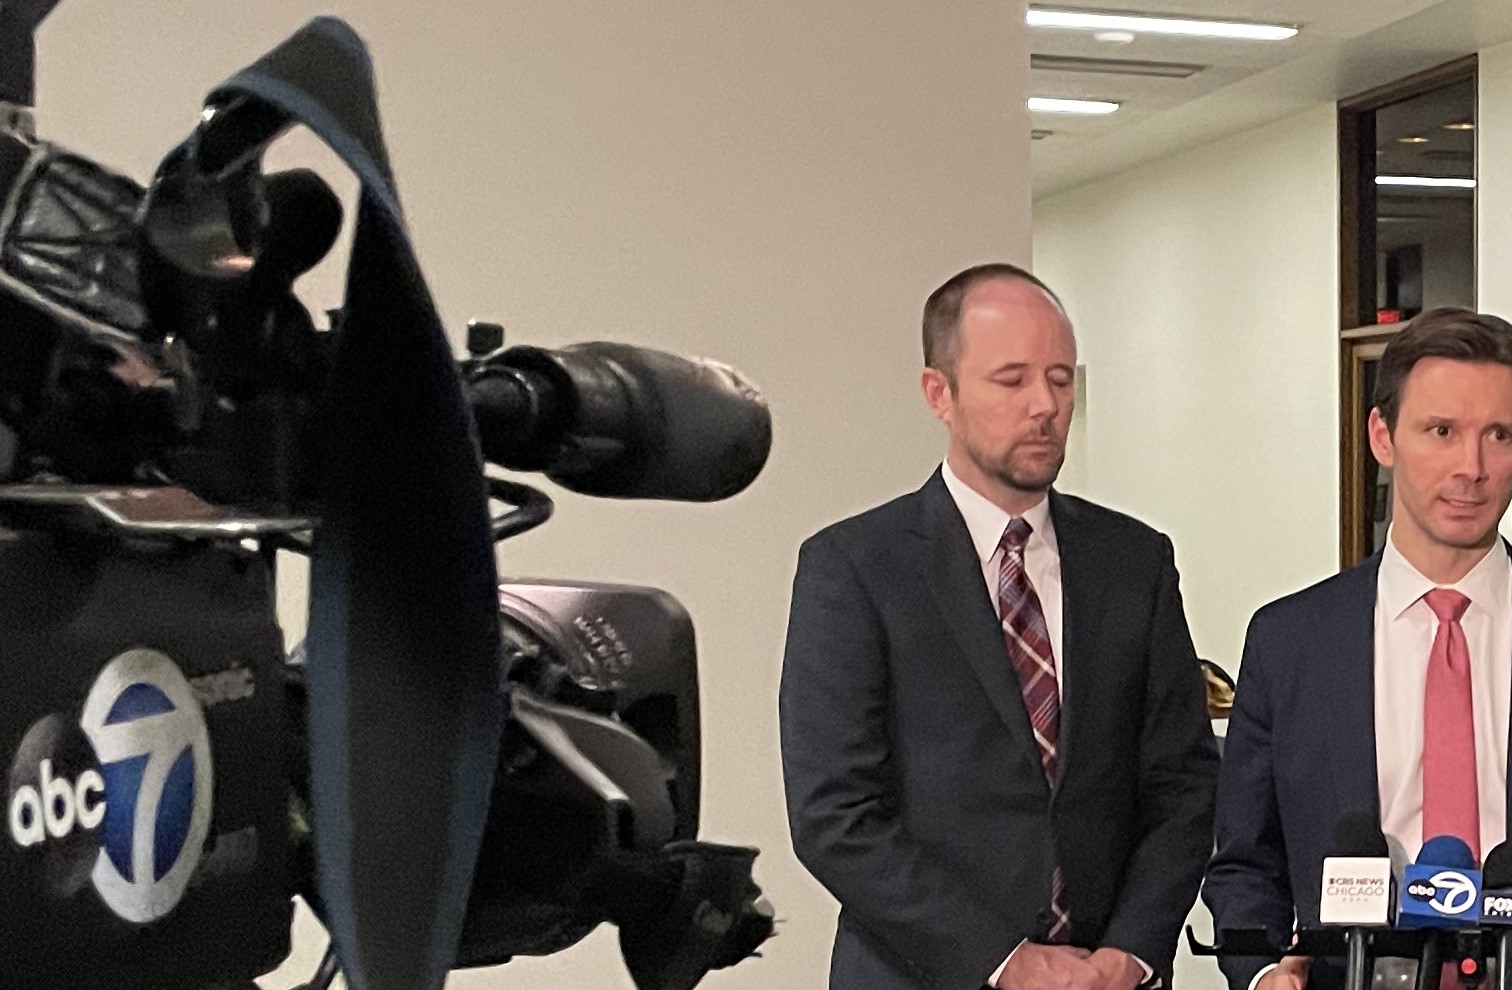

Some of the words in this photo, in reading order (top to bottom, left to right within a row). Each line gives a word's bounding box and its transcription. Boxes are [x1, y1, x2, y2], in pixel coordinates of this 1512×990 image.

[9, 758, 107, 847] abc
[80, 649, 213, 924] 7
[1326, 887, 1385, 896] CHICAGO
[1356, 878, 1384, 886] NEWS
[1429, 871, 1477, 914] 7
